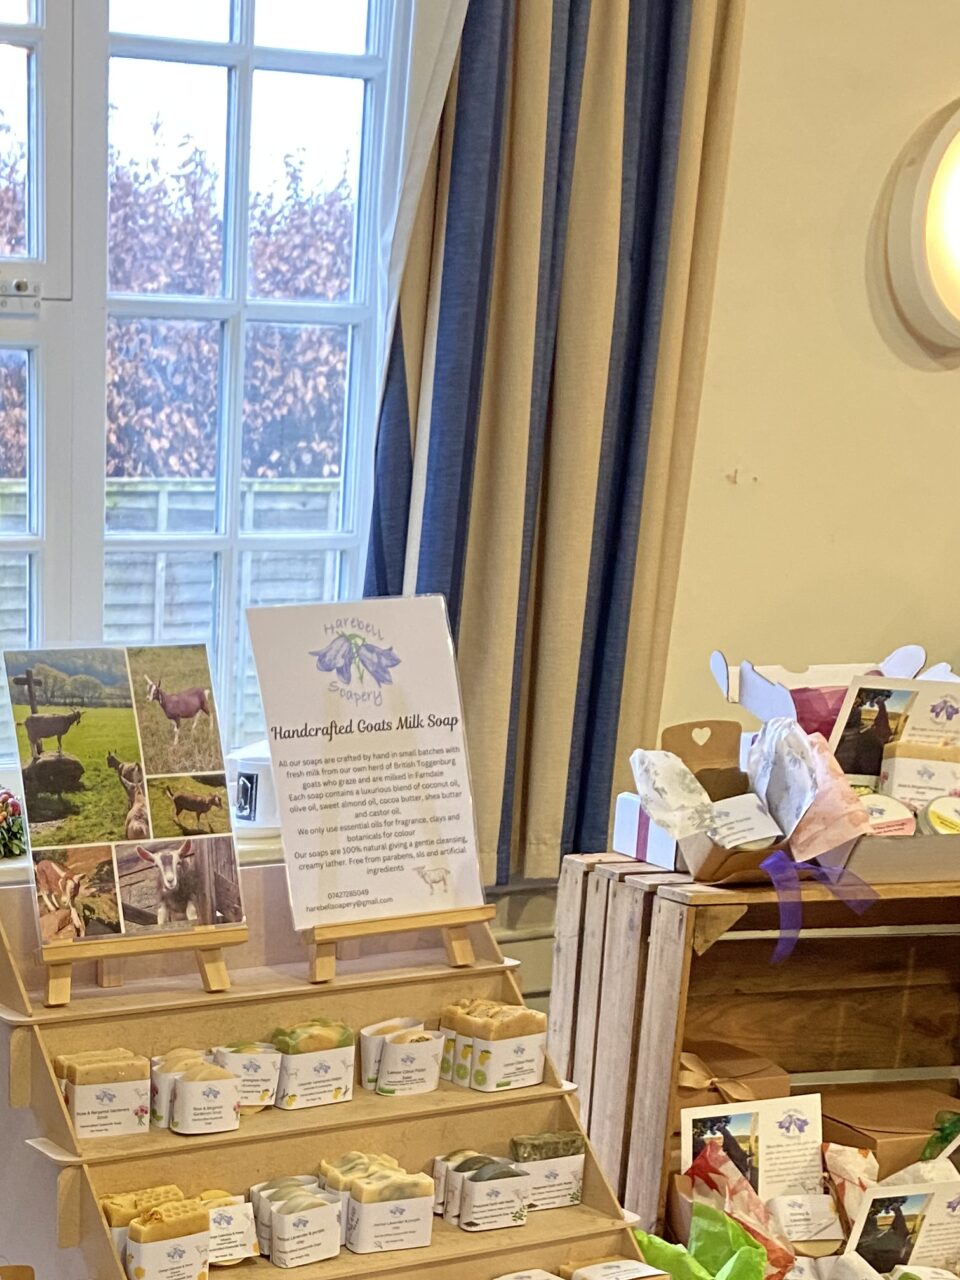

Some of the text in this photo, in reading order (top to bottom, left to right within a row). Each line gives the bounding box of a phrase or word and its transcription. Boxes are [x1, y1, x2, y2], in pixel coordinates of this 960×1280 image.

[324, 618, 384, 640] Harebell
[328, 681, 382, 706] Soapery
[271, 714, 458, 742] Handcrafted Goats Milk Soap
[336, 754, 361, 763] crafted
[362, 754, 371, 762] by
[418, 748, 444, 756] batches
[286, 770, 304, 778] fresh
[368, 763, 383, 771] herd
[416, 758, 456, 768] Toggenburg
[289, 793, 306, 801] Each
[325, 790, 354, 798] contains
[361, 786, 391, 795] luxurious
[393, 784, 412, 792] blend
[413, 782, 420, 790] of
[422, 781, 448, 789] coconut
[450, 779, 460, 787] oil,
[302, 781, 321, 790] goats
[339, 778, 356, 787] graze
[290, 805, 306, 813] olive
[308, 803, 319, 811] oil,
[320, 802, 340, 810] sweet
[341, 799, 366, 808] almond
[368, 798, 378, 806] oil,
[380, 797, 399, 805] cocoa
[441, 791, 462, 799] butter
[355, 807, 401, 819] and castor oil.
[310, 827, 324, 835] only
[340, 821, 369, 831] essential
[370, 820, 383, 828] oils
[395, 817, 428, 827] fragrance,
[429, 815, 446, 823] clays
[347, 829, 416, 842] botanicals for colour
[294, 851, 307, 859] Our
[308, 850, 328, 858] soaps
[343, 846, 362, 854] 100%
[363, 843, 387, 851] natural
[388, 841, 408, 851] giving
[414, 839, 435, 848] gentle
[436, 836, 468, 845] cleansing,
[298, 862, 324, 870] creamy
[325, 860, 347, 868] lather.
[383, 852, 415, 862] parabens,
[440, 846, 466, 855] artificial
[367, 865, 404, 876] ingredients
